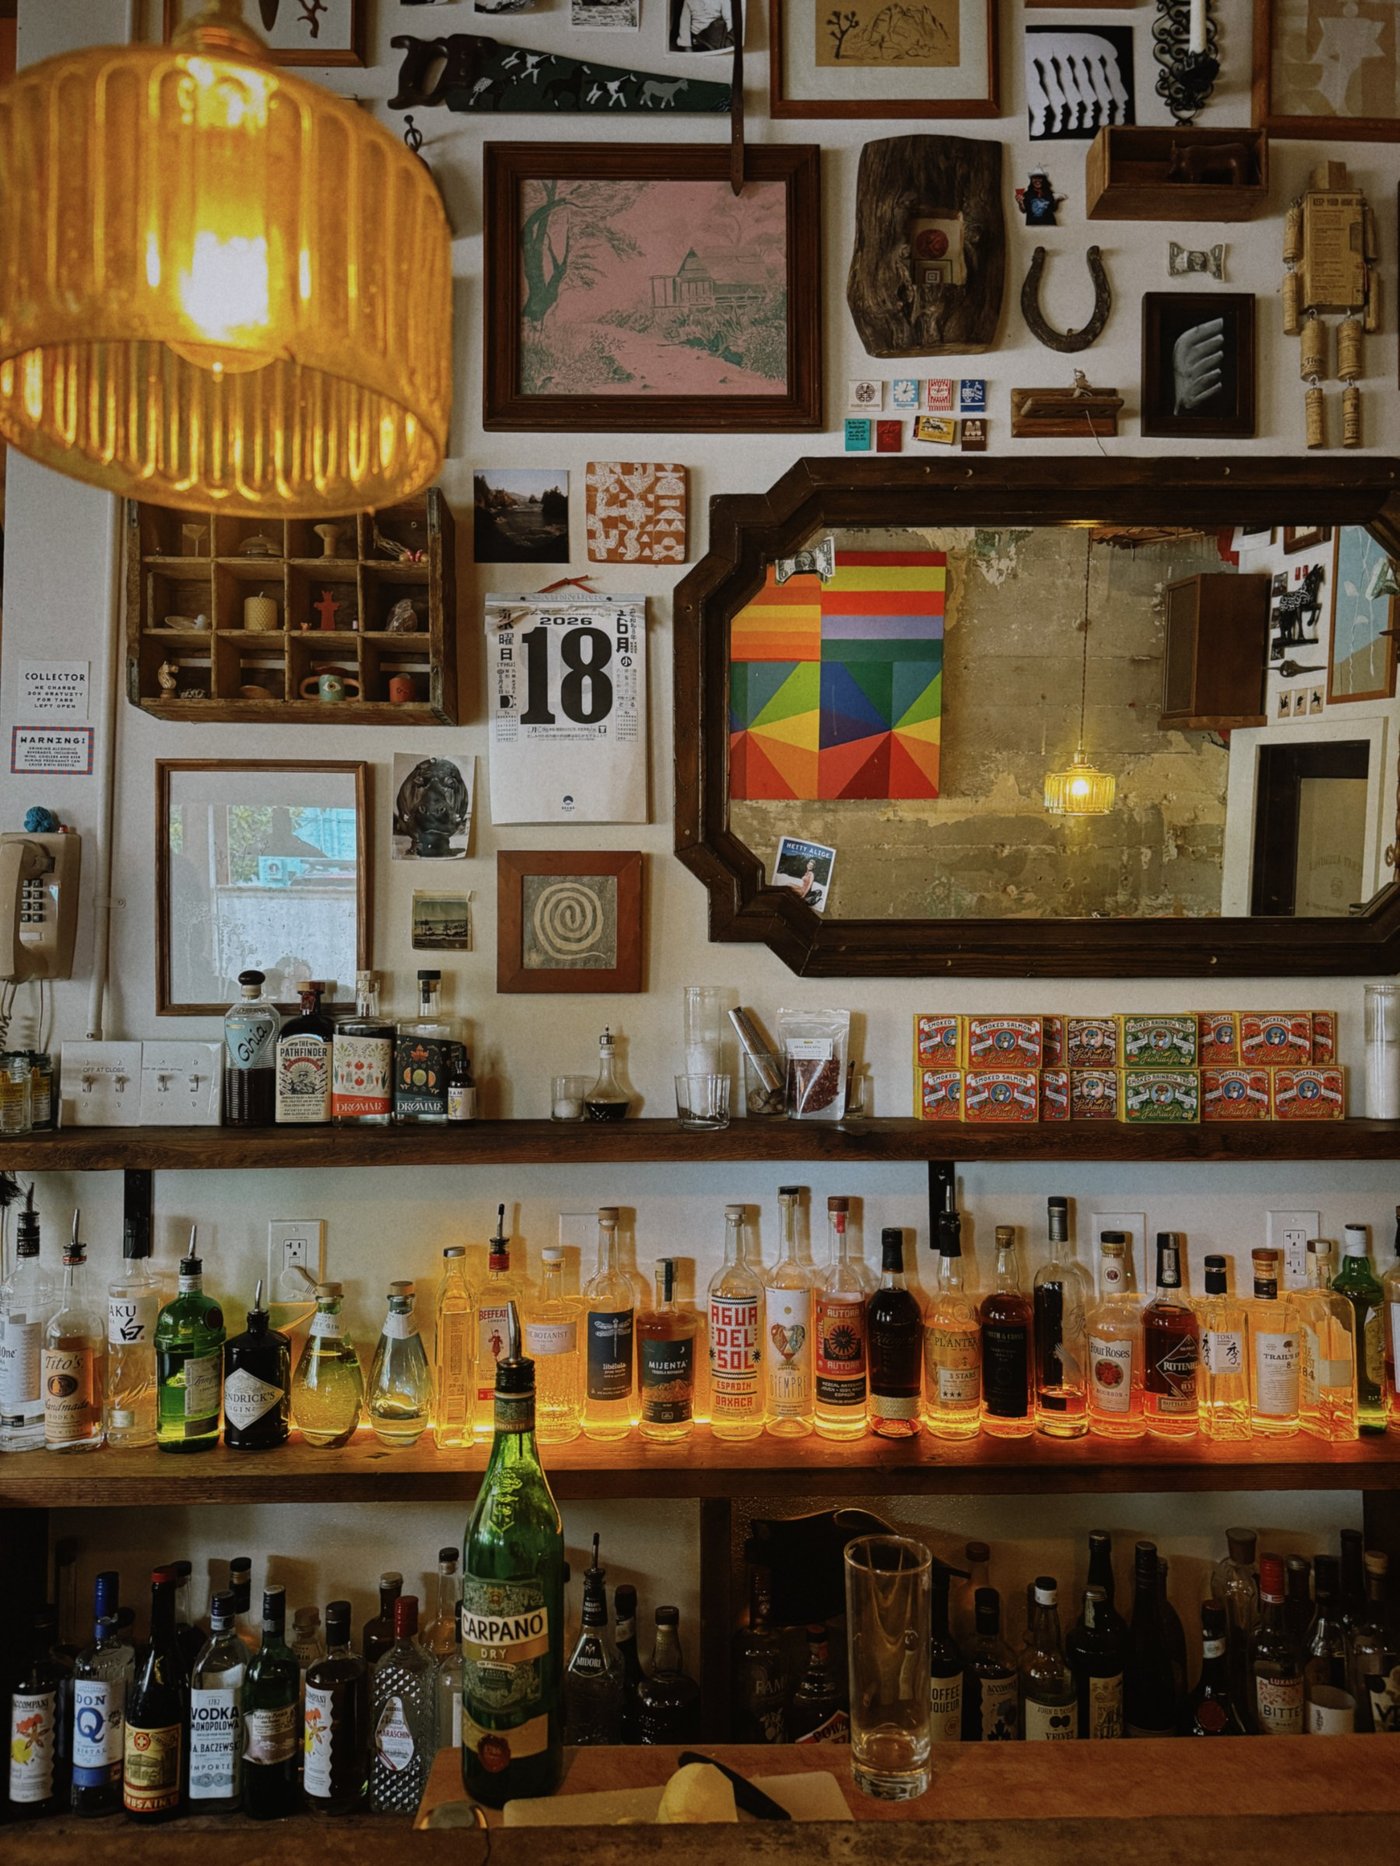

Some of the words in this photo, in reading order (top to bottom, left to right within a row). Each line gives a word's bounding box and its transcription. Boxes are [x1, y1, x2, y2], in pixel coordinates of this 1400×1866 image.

[540, 616, 592, 626] 2026
[25, 672, 86, 681] COLLECTOR
[520, 626, 613, 725] 18
[786, 842, 807, 852] HETTY
[809, 847, 830, 858] ALICE
[927, 1019, 952, 1029] SMOKED
[979, 1022, 1005, 1032] SMOKED
[1006, 1022, 1032, 1033] SALMON
[1261, 1016, 1290, 1028] MACKEREL
[238, 1024, 267, 1062] Ghia
[280, 1047, 328, 1057] PATHFINDER
[932, 1073, 957, 1083] SMOKED
[974, 1074, 1000, 1085] SMOKED
[1001, 1074, 1028, 1085] SALMON
[1220, 1070, 1249, 1082] MACKEREL
[1294, 1070, 1323, 1081] MACKEREL
[478, 1308, 508, 1321] BEEFEAT
[711, 1304, 758, 1326] AGUA
[716, 1327, 754, 1348] DEL
[1105, 1346, 1130, 1359] Roses
[648, 1360, 688, 1370] MIJENTA
[717, 1349, 755, 1370] SOL
[715, 1396, 753, 1408] OAXACA
[481, 1647, 507, 1659] DRY
[576, 1656, 602, 1667] MIDORI
[931, 1684, 960, 1701] OFFEE
[76, 1693, 108, 1706] DON
[930, 1698, 960, 1714] IQUEUR
[1263, 1704, 1301, 1718] BITTE
[191, 1705, 240, 1720] VODKA
[76, 1706, 107, 1744] Q
